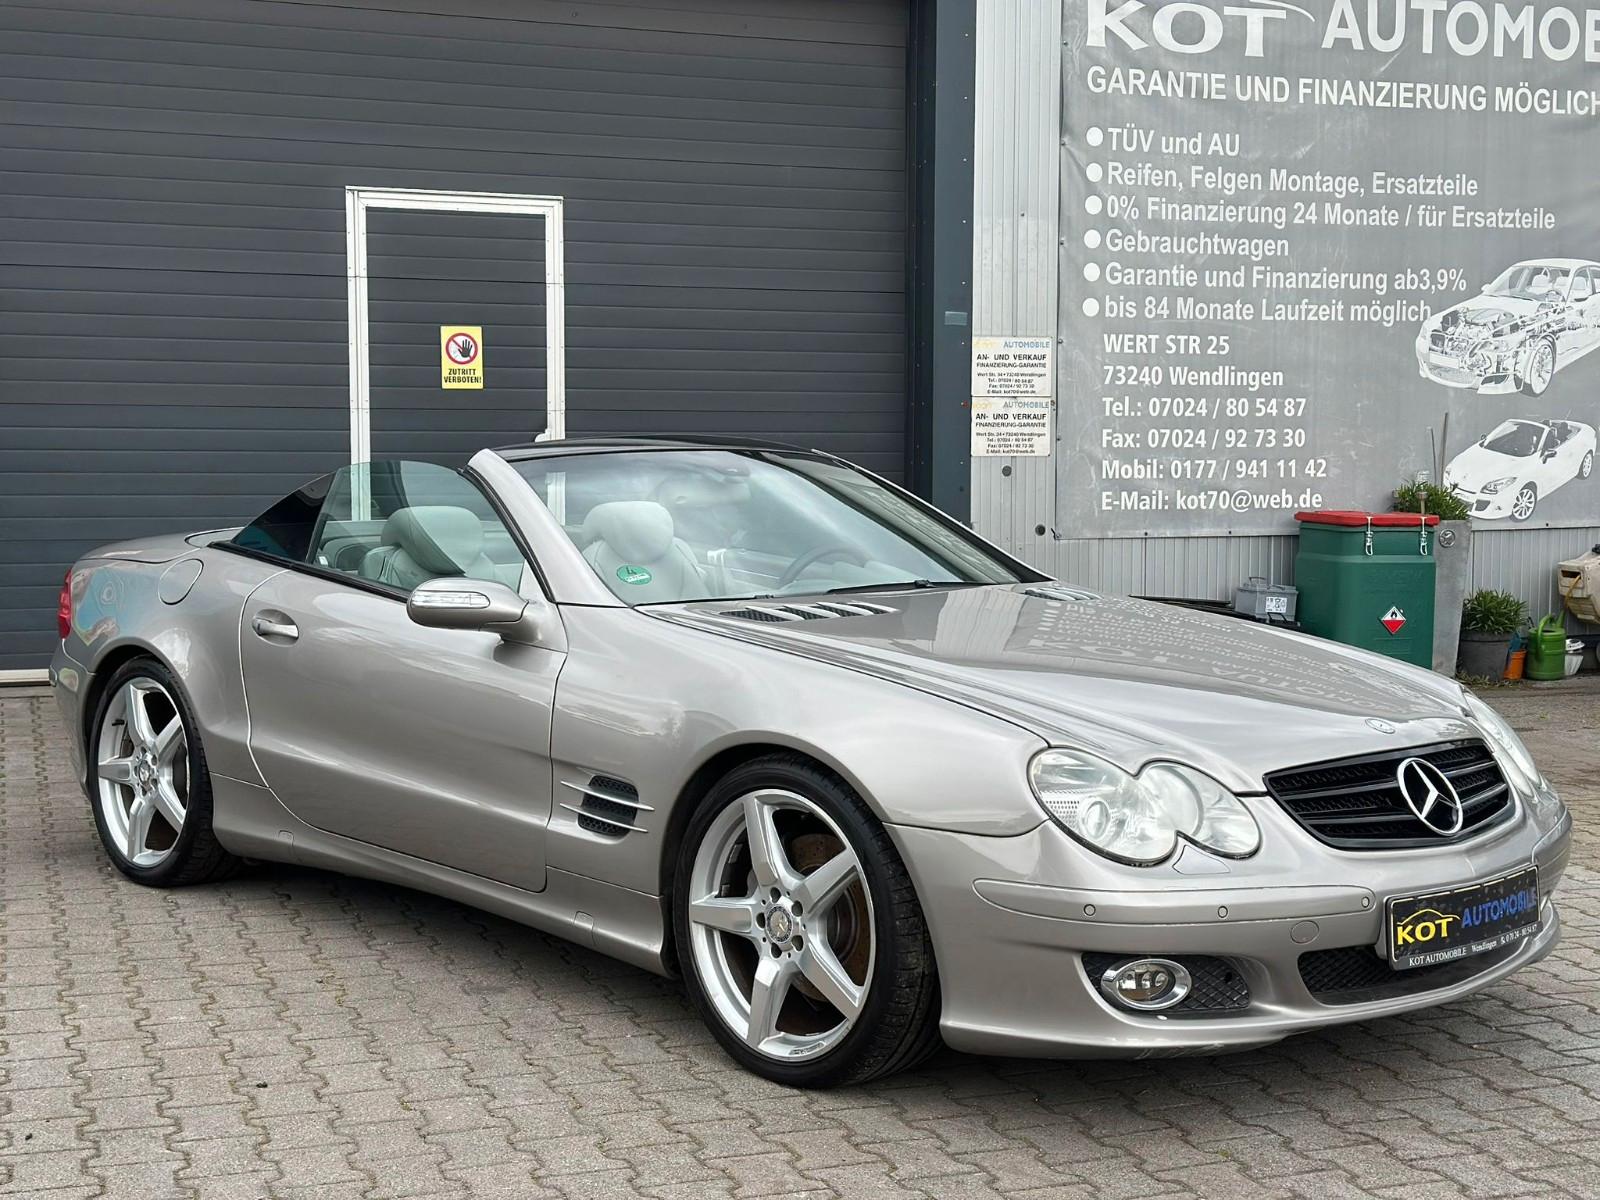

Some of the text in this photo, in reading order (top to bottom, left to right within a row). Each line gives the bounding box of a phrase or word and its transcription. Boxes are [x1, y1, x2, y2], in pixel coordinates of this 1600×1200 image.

[1086, 0, 1286, 57] KOT
[1088, 66, 1226, 99] GARANTIE
[1236, 75, 1289, 102] UND
[1299, 78, 1486, 110] FINANZIERUNG
[1108, 123, 1239, 156] TÜV und AU
[1108, 162, 1477, 198] Reifen, Felgen Montage, Ersatzteile
[1105, 194, 1555, 229] 0% Finanzierung 24 Monate / für Ersatzteile
[1106, 228, 1288, 261] Gebrauchtwagen
[1106, 262, 1466, 295] Garantie und Finanzierung ab3,9%
[1106, 295, 1432, 328] bis 84 Monate Laufzeit möglich
[1003, 341, 1050, 349] AUTOMOBILE
[1104, 334, 1229, 354] WERT STR 25
[1104, 366, 1283, 391] 73240 Wendlingen
[1102, 396, 1306, 419] Tel.: 07024 / 80 54 87
[1103, 429, 1305, 449] Fax: 07024 / 92 73 30
[1103, 458, 1326, 480] Mobil: 0177 / 941 11 42
[1102, 488, 1322, 512] E-Mail: kot70@web.de
[1397, 889, 1536, 945] KOT AUTOMOBILE
[1409, 956, 1425, 966] KOT
[1426, 948, 1467, 963] AUTOMOBILE
